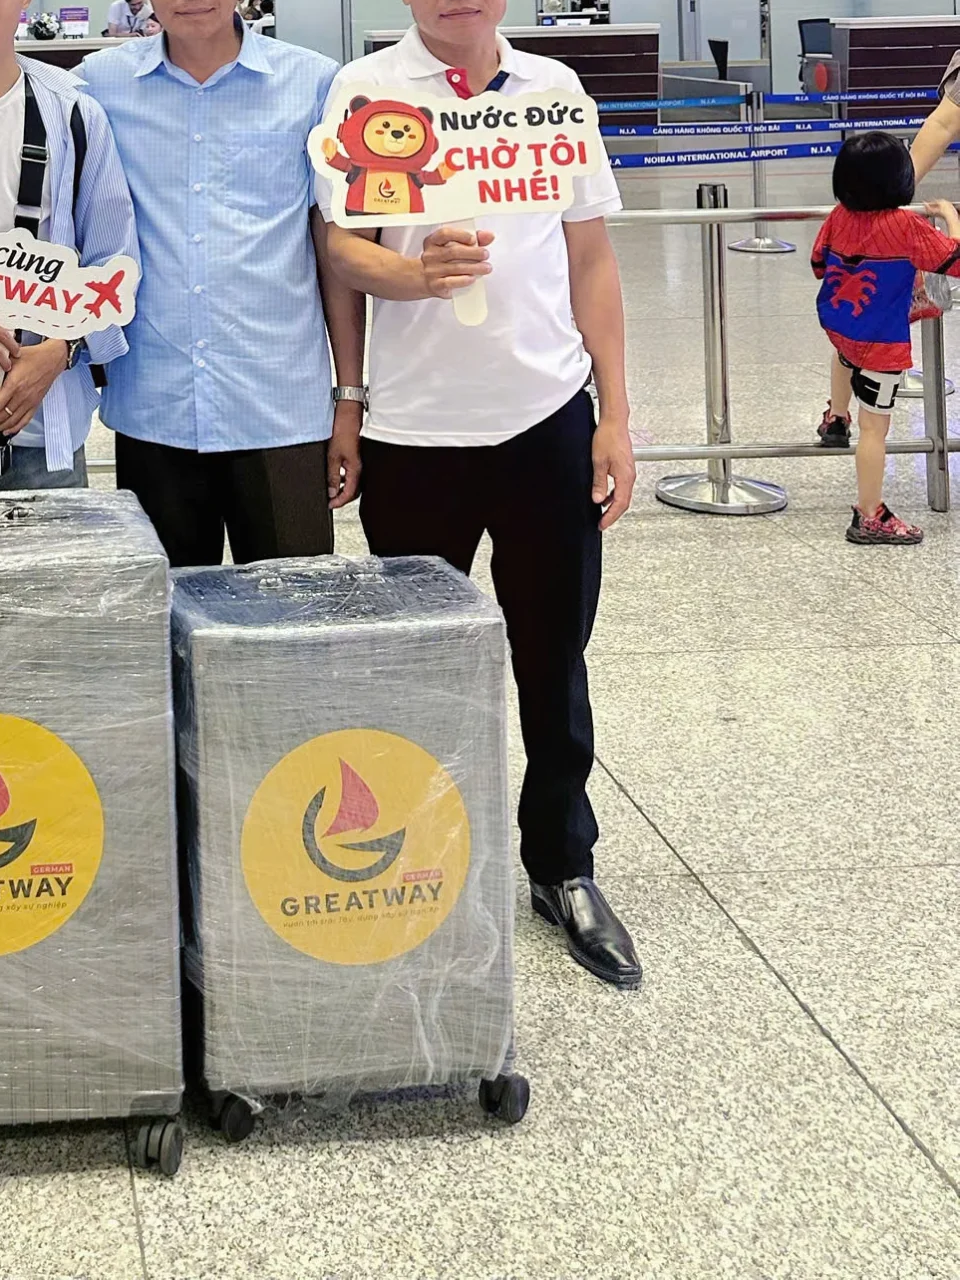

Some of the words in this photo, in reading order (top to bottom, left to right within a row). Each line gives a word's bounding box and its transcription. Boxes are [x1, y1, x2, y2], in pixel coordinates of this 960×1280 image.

[440, 106, 517, 131] Nước
[524, 101, 585, 127] Đức
[854, 120, 907, 128] INTERNATIONAL
[445, 137, 520, 171] CHỜ
[527, 133, 587, 166] TÔI
[644, 156, 675, 165] NOIBAI
[677, 152, 748, 163] INTERNATIONAL
[751, 148, 788, 158] AIRPORT
[478, 169, 560, 203] NHÉ!
[33, 865, 71, 873] GERMAN
[280, 881, 443, 917] GREATWAY
